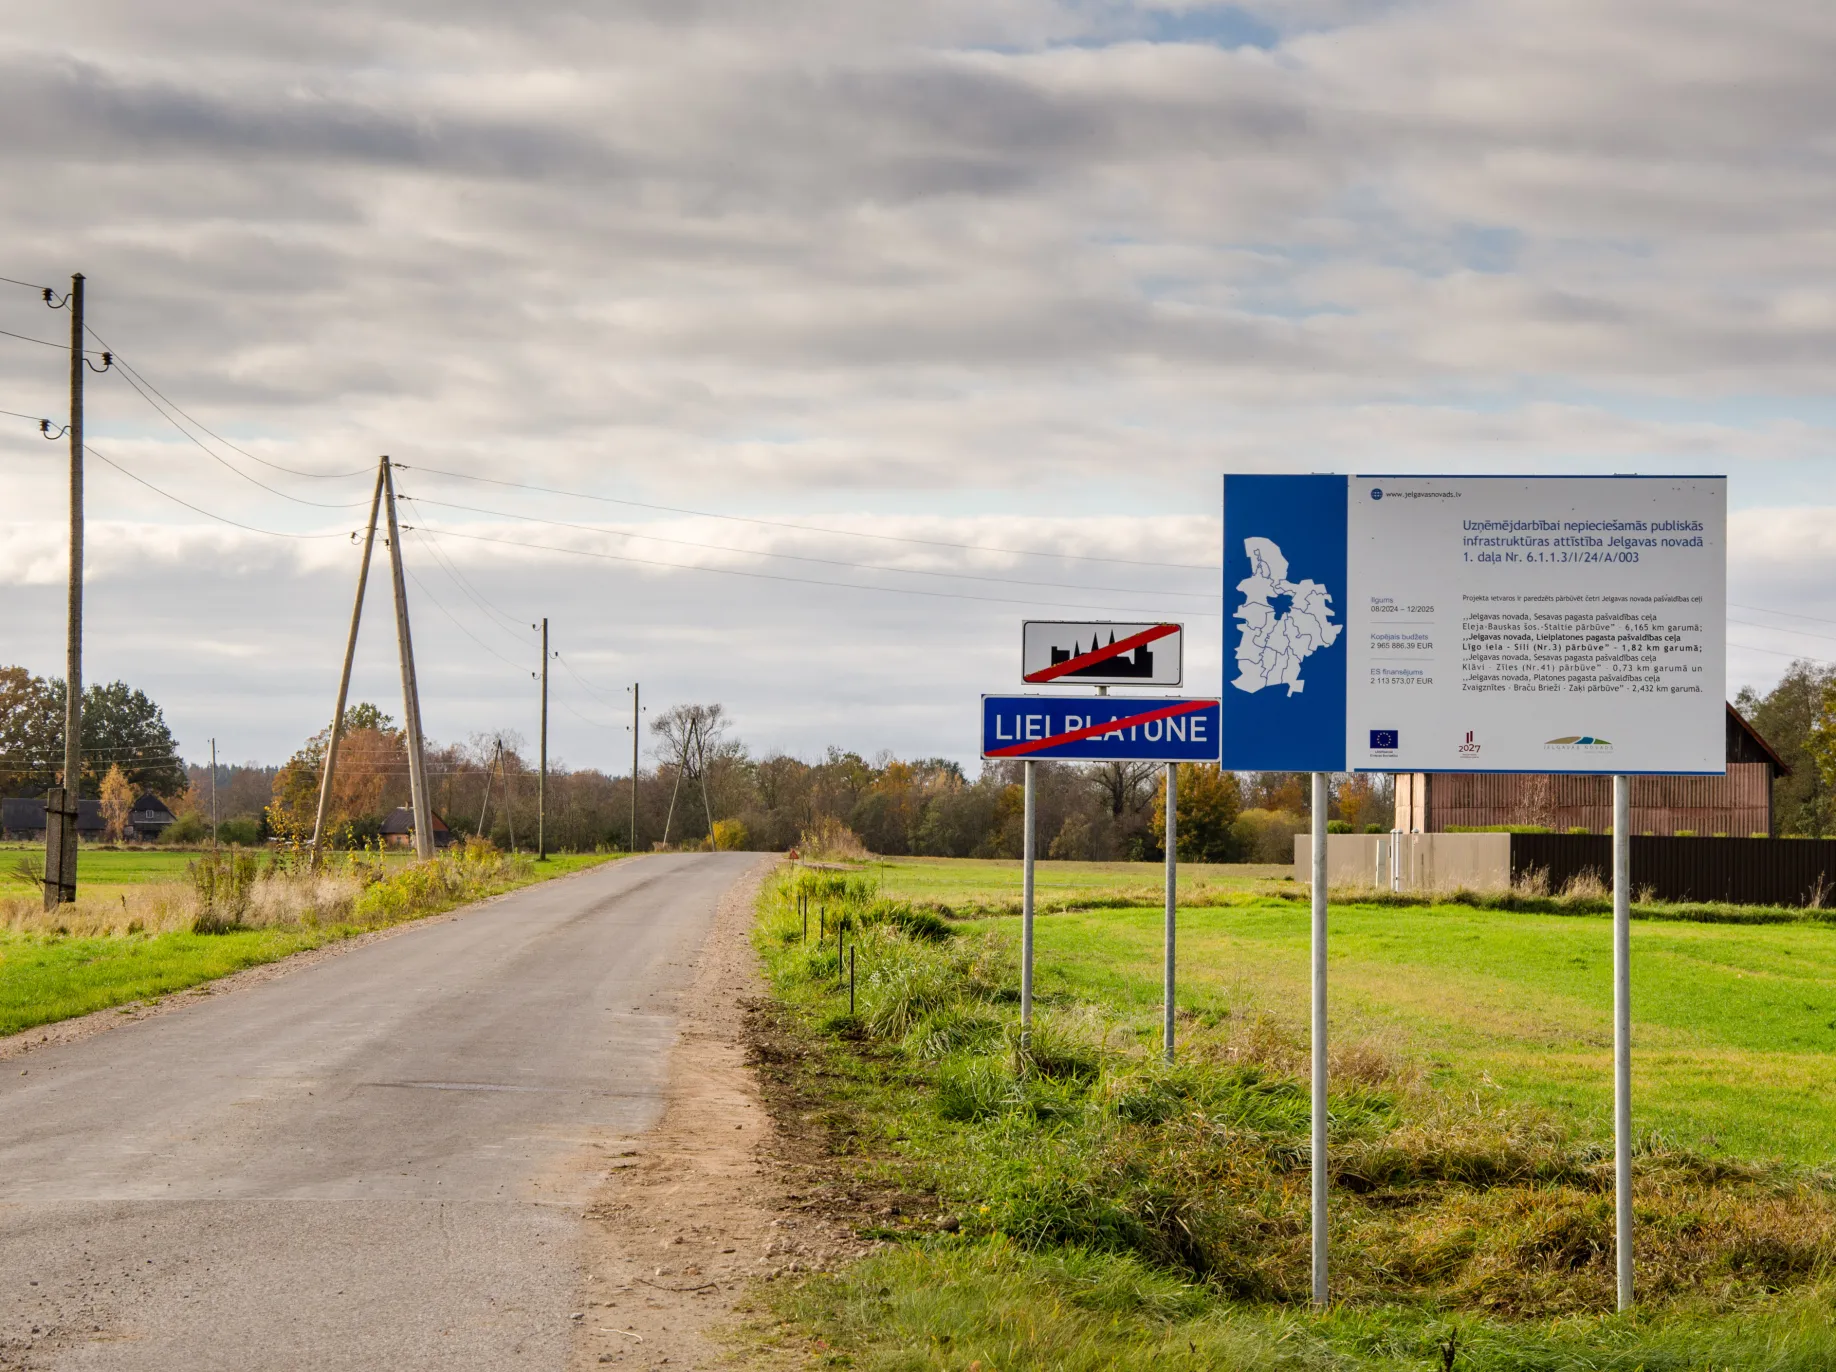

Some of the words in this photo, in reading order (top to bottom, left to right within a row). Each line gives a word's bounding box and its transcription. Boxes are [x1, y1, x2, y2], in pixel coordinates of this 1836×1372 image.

[1386, 491, 1462, 499] www.jelgavasnovads.lv
[1463, 519, 1560, 534] Uzņēmējdarbībai
[1564, 519, 1648, 533] nepieciešamās
[1651, 519, 1704, 533] publiskās
[1463, 535, 1550, 547] infrastruktūras
[1553, 536, 1603, 547] attīstība
[1607, 536, 1657, 550] Jelgavas
[1661, 536, 1703, 547] novadā
[1464, 552, 1473, 563] 1.
[1477, 552, 1502, 565] daļa
[1506, 552, 1522, 563] Nr.
[1526, 552, 1639, 564] 6.1.1.3/I/24/A/003
[1462, 595, 1489, 603] Projekta
[1523, 595, 1554, 603] paredzēts
[1555, 595, 1584, 603] pārbūvēt
[1653, 595, 1690, 603] pašvaldības
[1502, 613, 1531, 621] novada,
[1564, 613, 1594, 622] pagasta
[1596, 613, 1639, 622] pašvaldības
[1641, 614, 1657, 622] ceļa
[1625, 624, 1649, 632] 6,165
[1667, 624, 1703, 632] garumā;
[1503, 633, 1534, 641] novada,
[1536, 633, 1584, 642] Lielplatones
[1617, 634, 1663, 642] pašvaldības
[1664, 634, 1681, 642] ceļa
[1462, 643, 1482, 652] Līgo
[1622, 644, 1643, 652] 1,82
[1664, 645, 1702, 653] garumā;
[1533, 653, 1563, 661] Sesavas
[1564, 654, 1593, 662] pagasta
[1595, 654, 1639, 662] pašvaldības
[1640, 654, 1657, 663] ceļa
[1613, 664, 1633, 672] 0,73
[1654, 665, 1688, 673] garumā
[1502, 674, 1531, 682] novada,
[1599, 674, 1642, 682] pašvaldības
[1644, 675, 1660, 683] ceļa
[1462, 684, 1505, 692] Zvaigznītes
[1632, 685, 1654, 693] 2,432
[1671, 686, 1703, 694] garumā.
[996, 714, 1208, 742] LIELPLATONE
[1458, 744, 1481, 753] 2027
